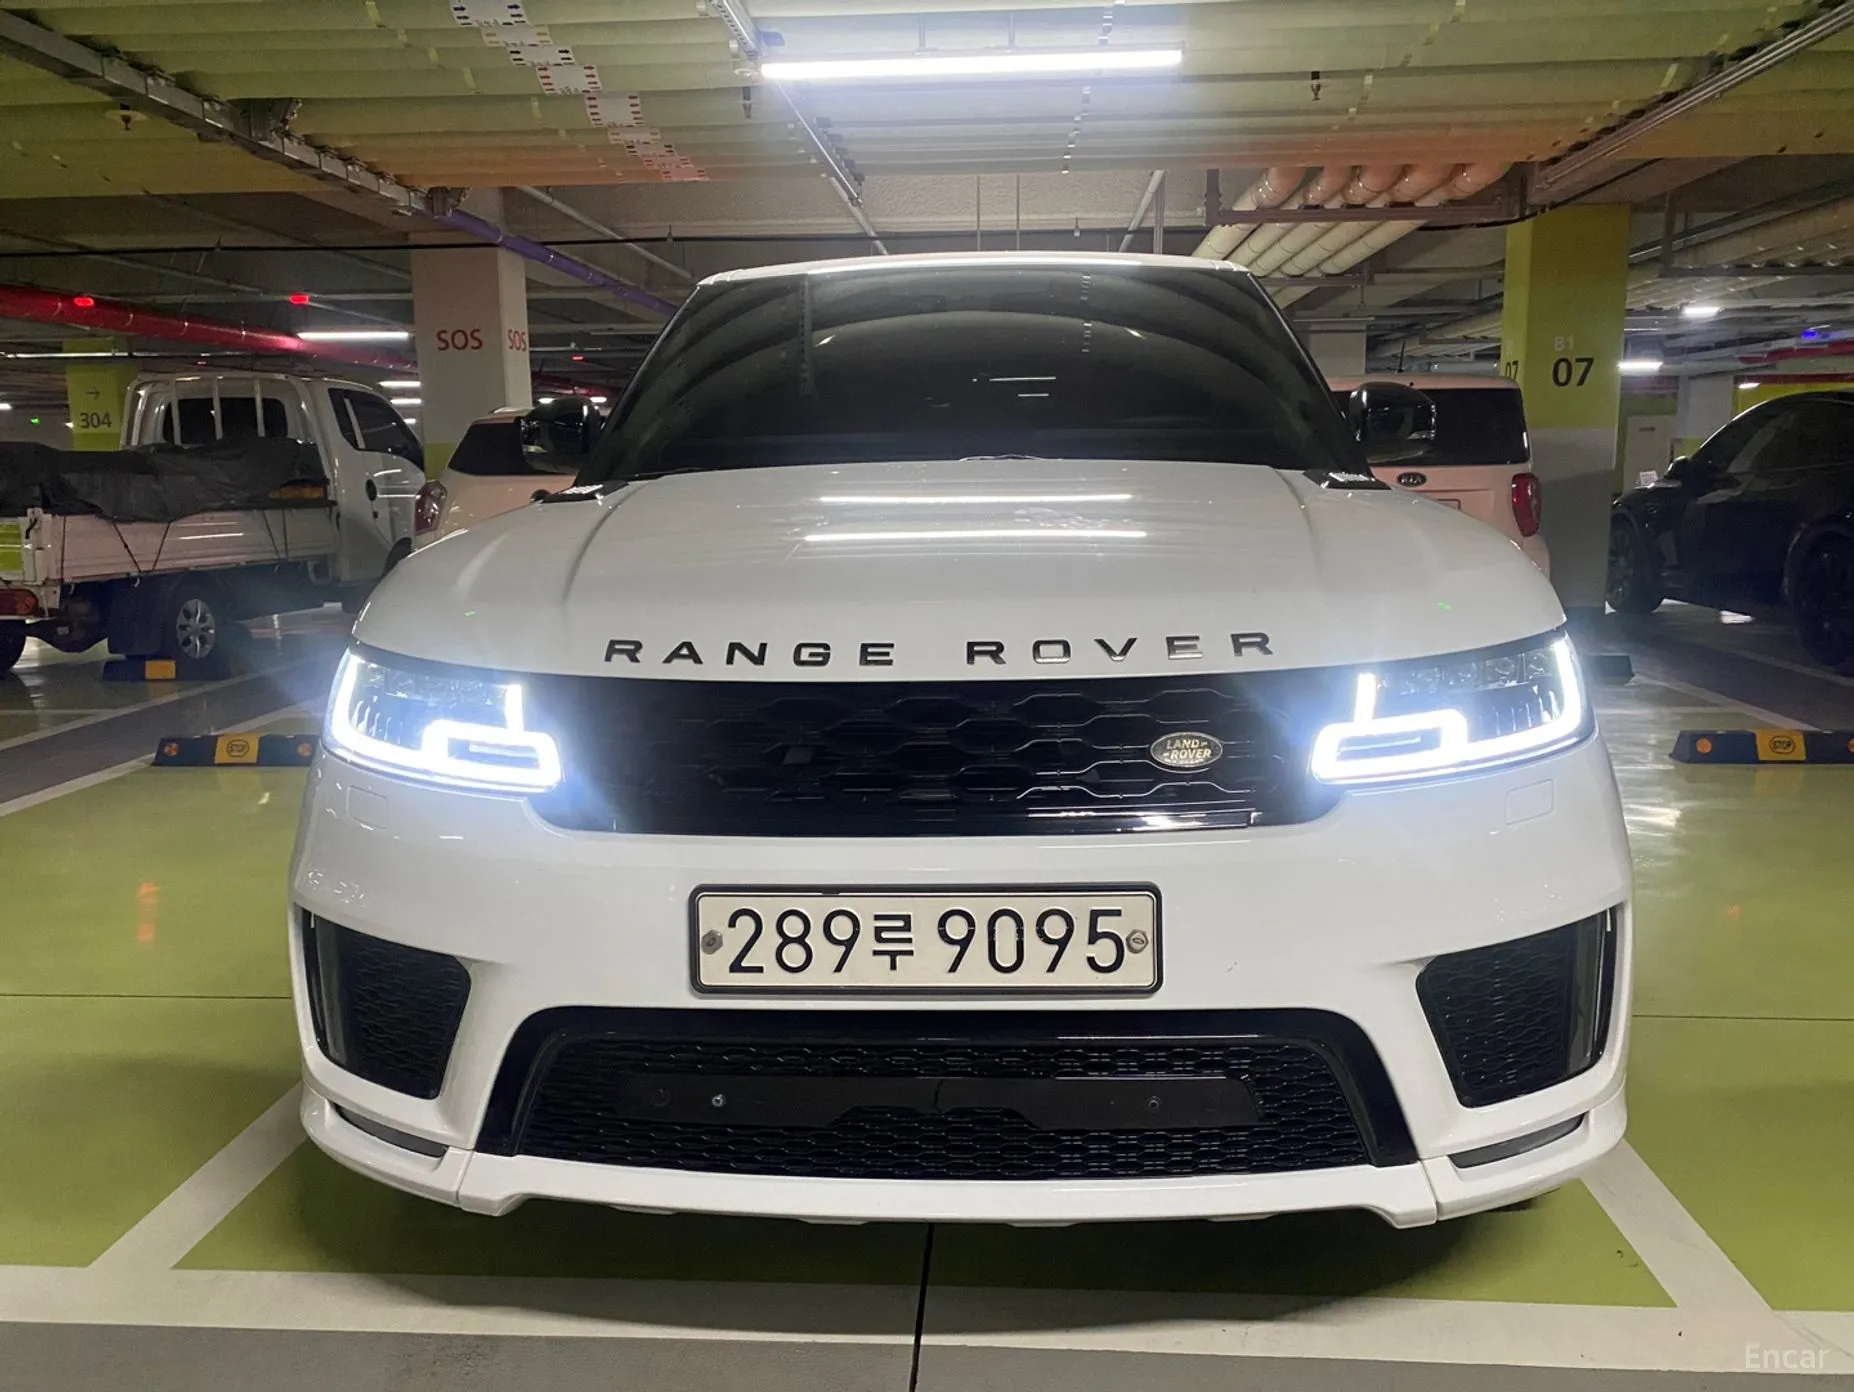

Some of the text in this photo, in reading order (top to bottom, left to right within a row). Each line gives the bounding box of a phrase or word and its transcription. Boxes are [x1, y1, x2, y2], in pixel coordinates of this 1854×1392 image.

[436, 329, 483, 351] SOS
[507, 329, 527, 351] SOS
[1554, 335, 1574, 351] B1
[1552, 357, 1594, 387] 07
[80, 412, 112, 429] 304
[604, 632, 1273, 666] RANGE ROVER
[230, 743, 248, 753] STOP
[1771, 740, 1793, 750] STOP
[727, 908, 1125, 974] 289루 9095
